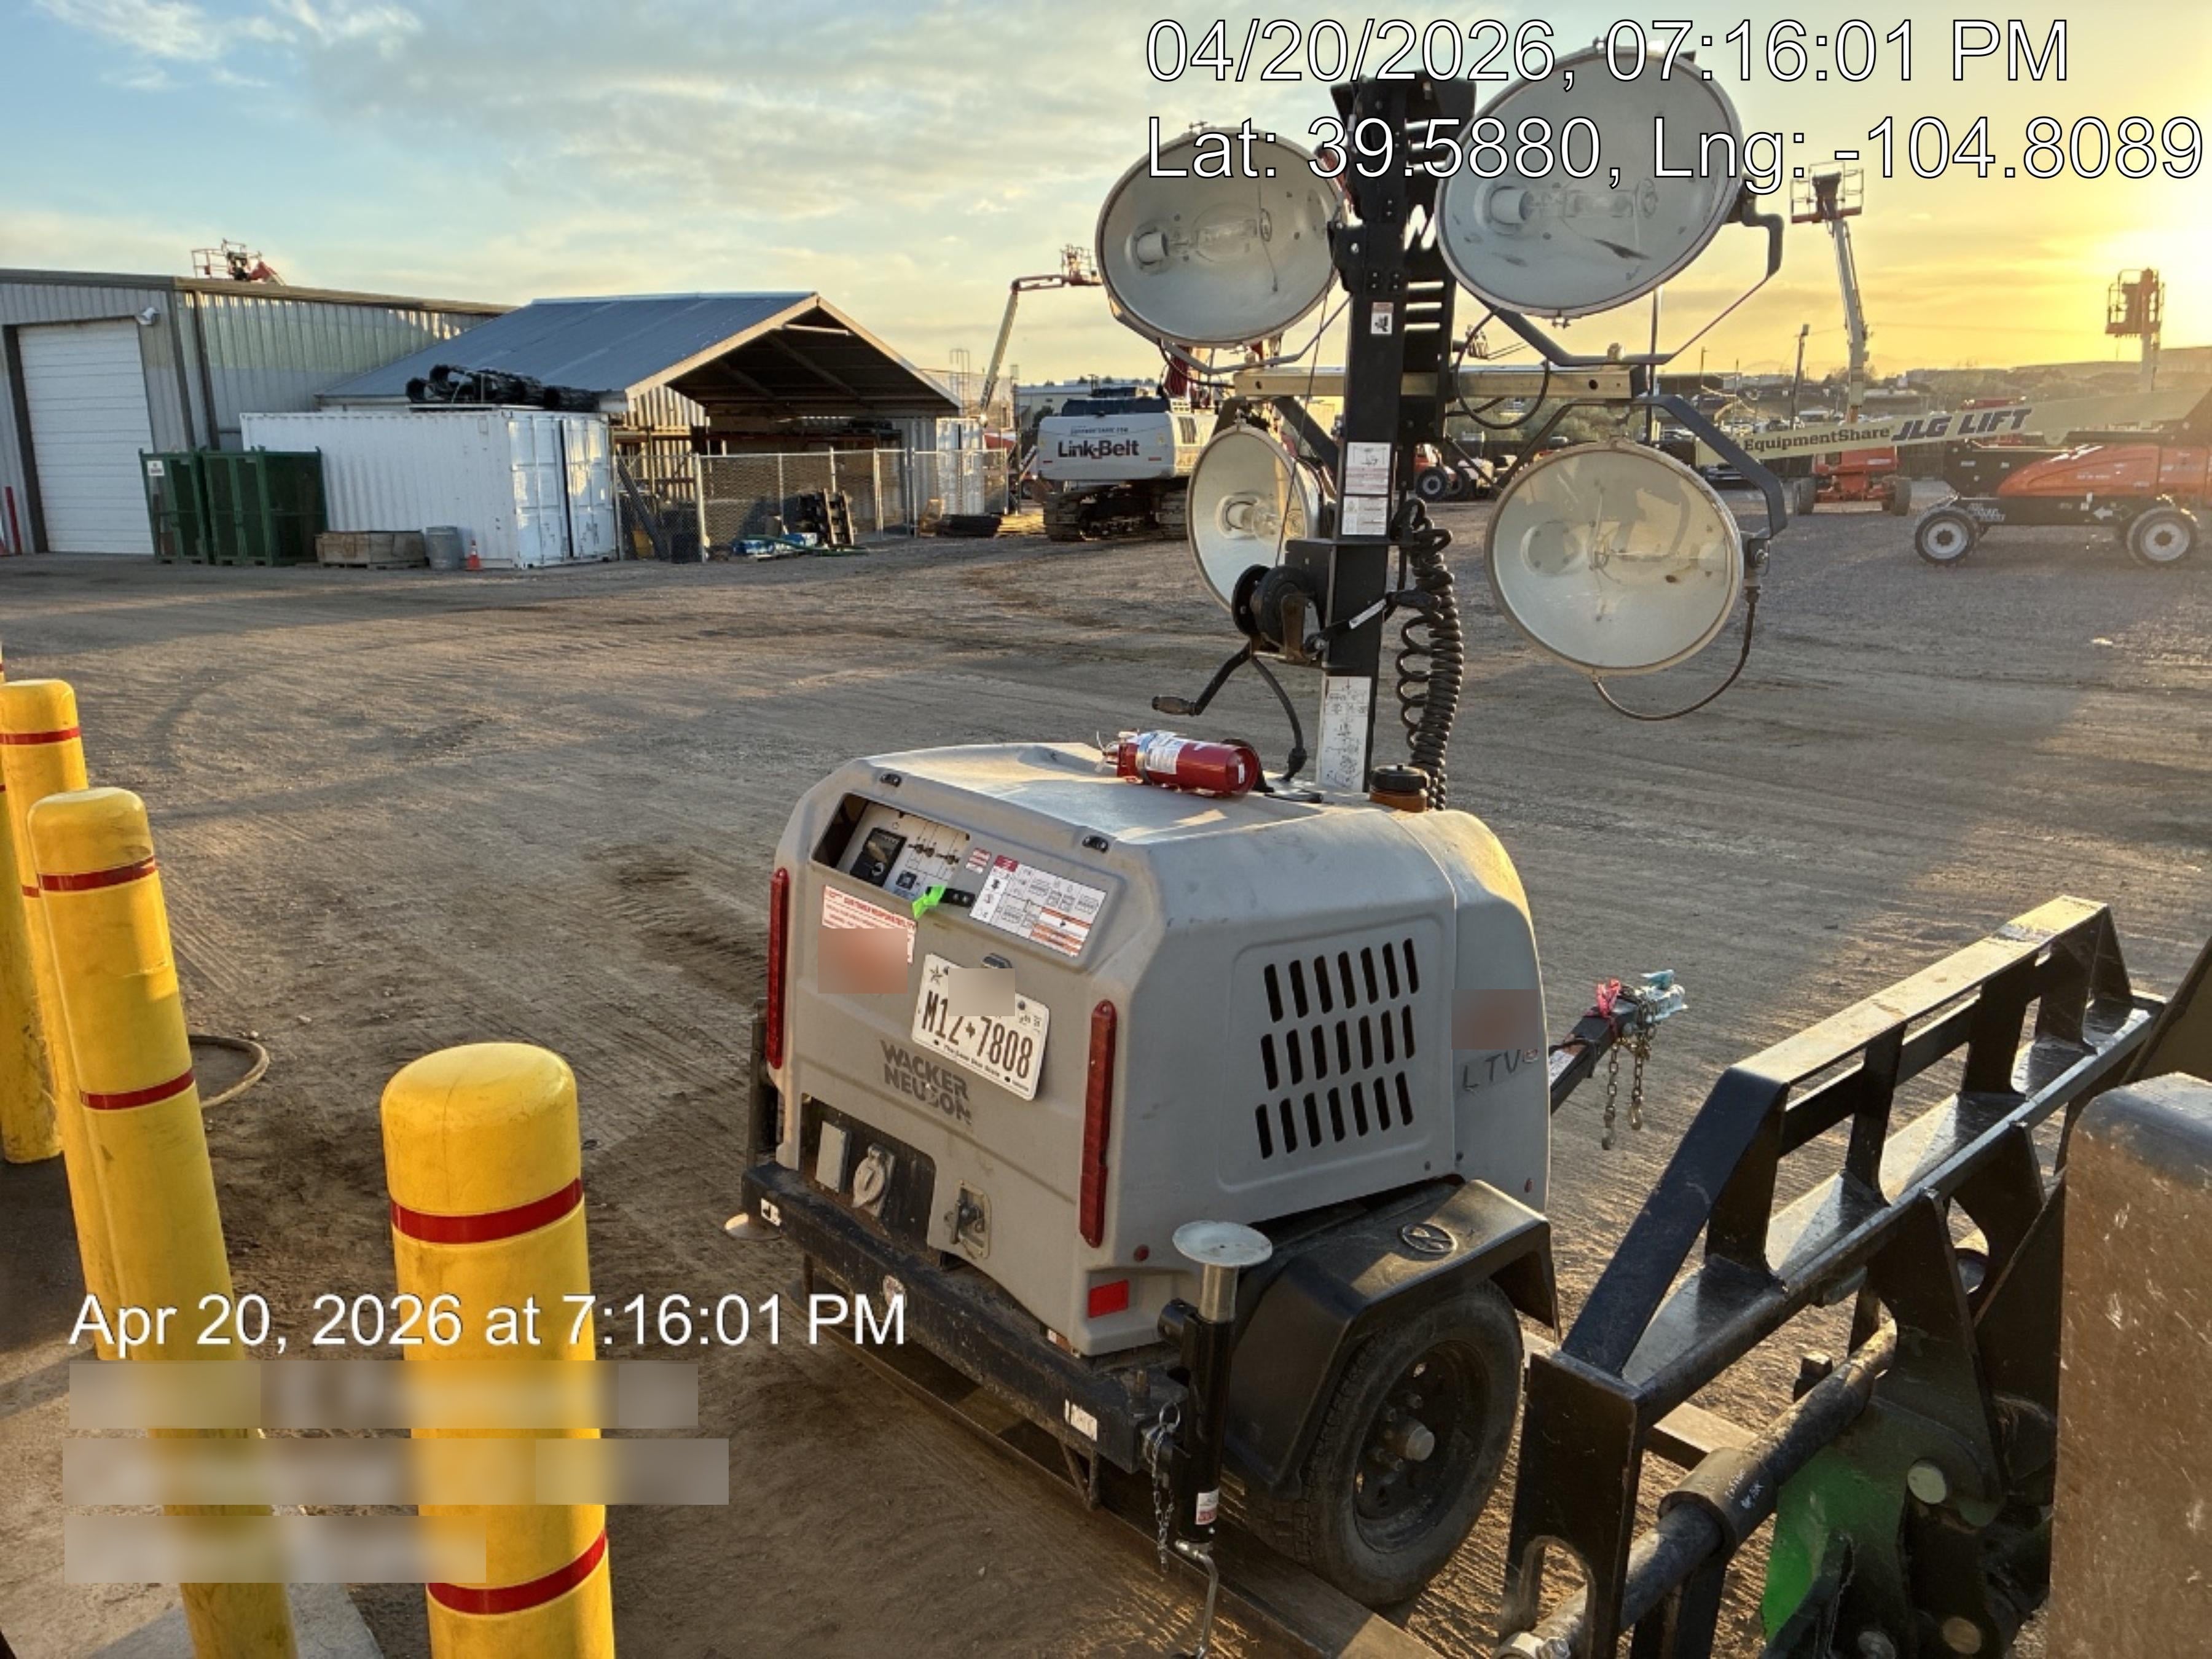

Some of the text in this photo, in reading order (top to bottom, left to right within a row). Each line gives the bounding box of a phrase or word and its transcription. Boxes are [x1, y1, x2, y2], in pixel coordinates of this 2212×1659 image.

[1058, 439, 1140, 459] Link-Belt
[1744, 409, 2032, 452] EquipmentShare JLG LIFT
[880, 1040, 970, 1102] WACKER
